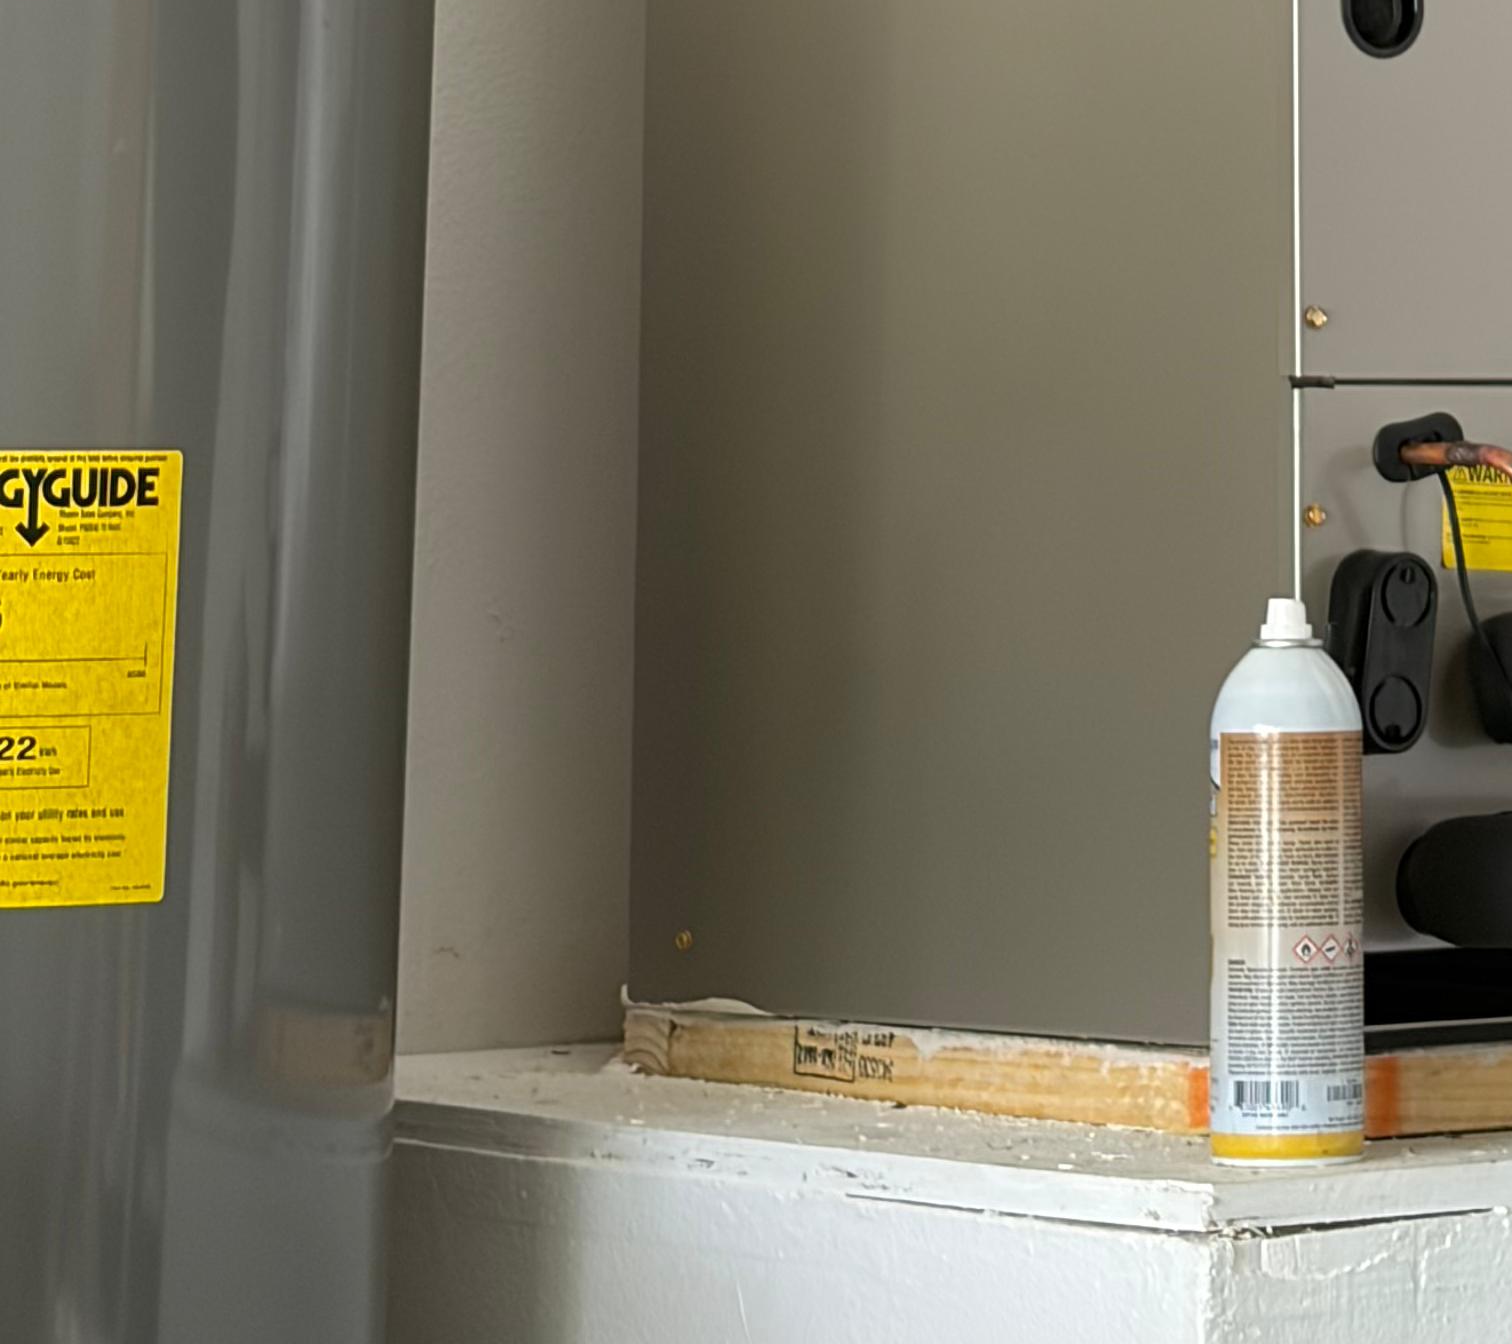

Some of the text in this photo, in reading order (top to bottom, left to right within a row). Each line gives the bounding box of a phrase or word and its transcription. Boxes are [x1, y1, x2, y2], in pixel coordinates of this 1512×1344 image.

[0, 467, 161, 510] GYGUIDE
[0, 567, 96, 583] early Energy Cost
